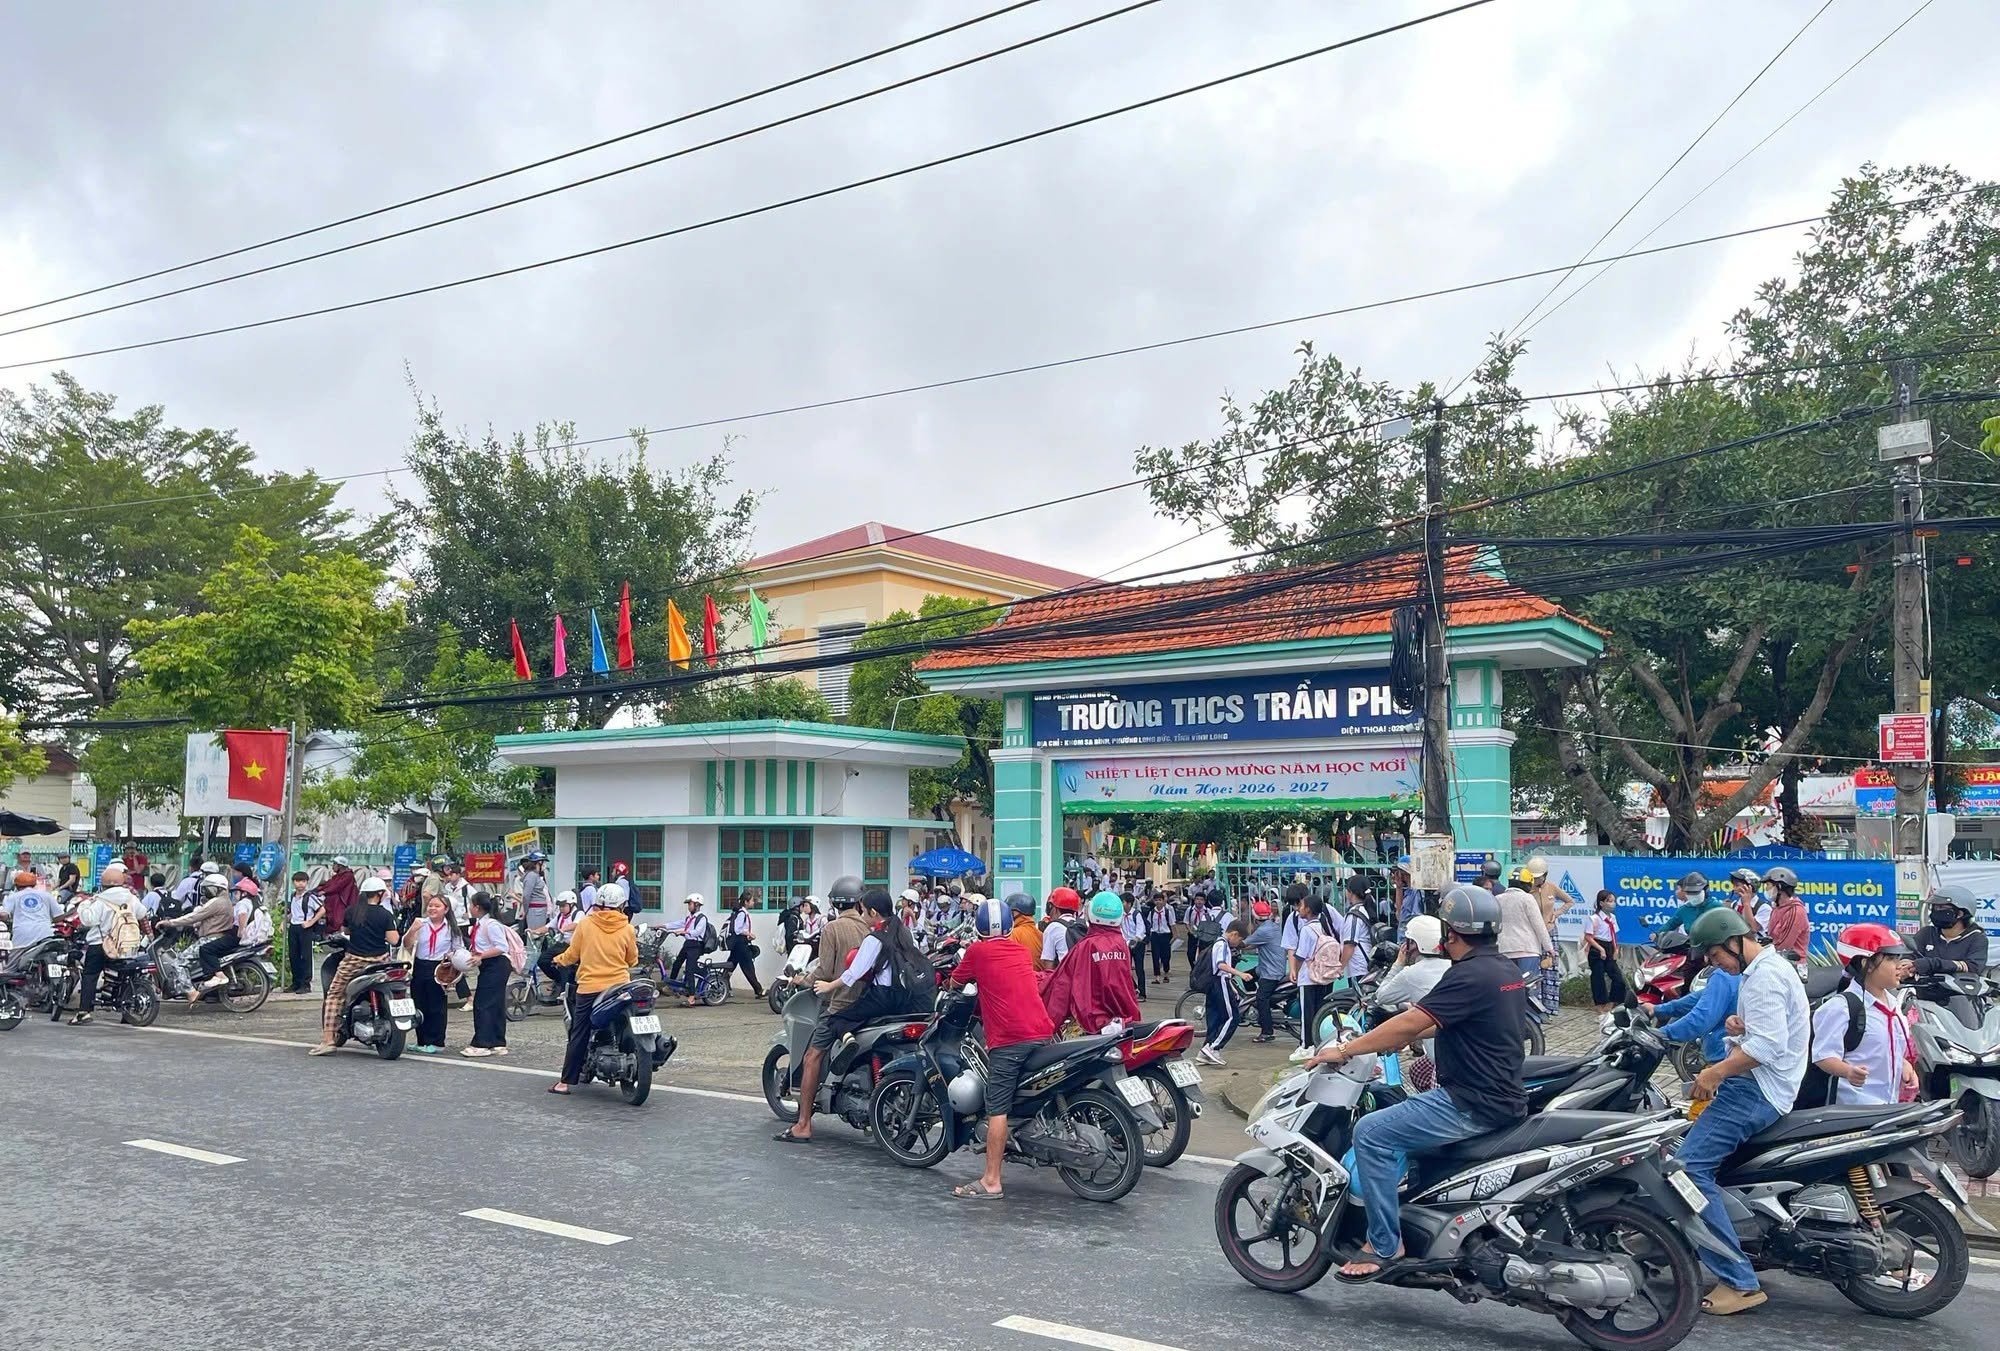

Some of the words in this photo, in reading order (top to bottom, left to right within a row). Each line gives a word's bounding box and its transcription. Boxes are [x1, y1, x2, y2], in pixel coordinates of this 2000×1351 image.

[1058, 694, 1162, 731] TRƯỜNG
[1172, 697, 1244, 726] THCS
[1254, 679, 1336, 722] TRẦN
[1341, 726, 1360, 735] ĐIỆN
[1085, 766, 1131, 781] NHIỆT
[1135, 766, 1169, 780] LIỆT
[1174, 764, 1221, 777] CHÀO
[1226, 763, 1276, 776] MỪNG
[1281, 762, 1320, 774] NĂM
[1326, 762, 1364, 776] HỌC
[1370, 758, 1406, 772] MỚI
[1149, 784, 1188, 795] Năm
[1195, 783, 1233, 796] Học:
[1238, 783, 1275, 794] 2026
[1289, 782, 1329, 793] 2027
[1620, 875, 1663, 893] CUỘC
[1795, 882, 1837, 895] SINH
[1843, 879, 1883, 897] GIỎI
[1617, 891, 1645, 908] GIẢI
[1814, 899, 1852, 916] CẦM
[1856, 904, 1890, 917] TAY
[1976, 898, 1996, 910] EX
[1567, 1165, 1600, 1184] YAMAHA
